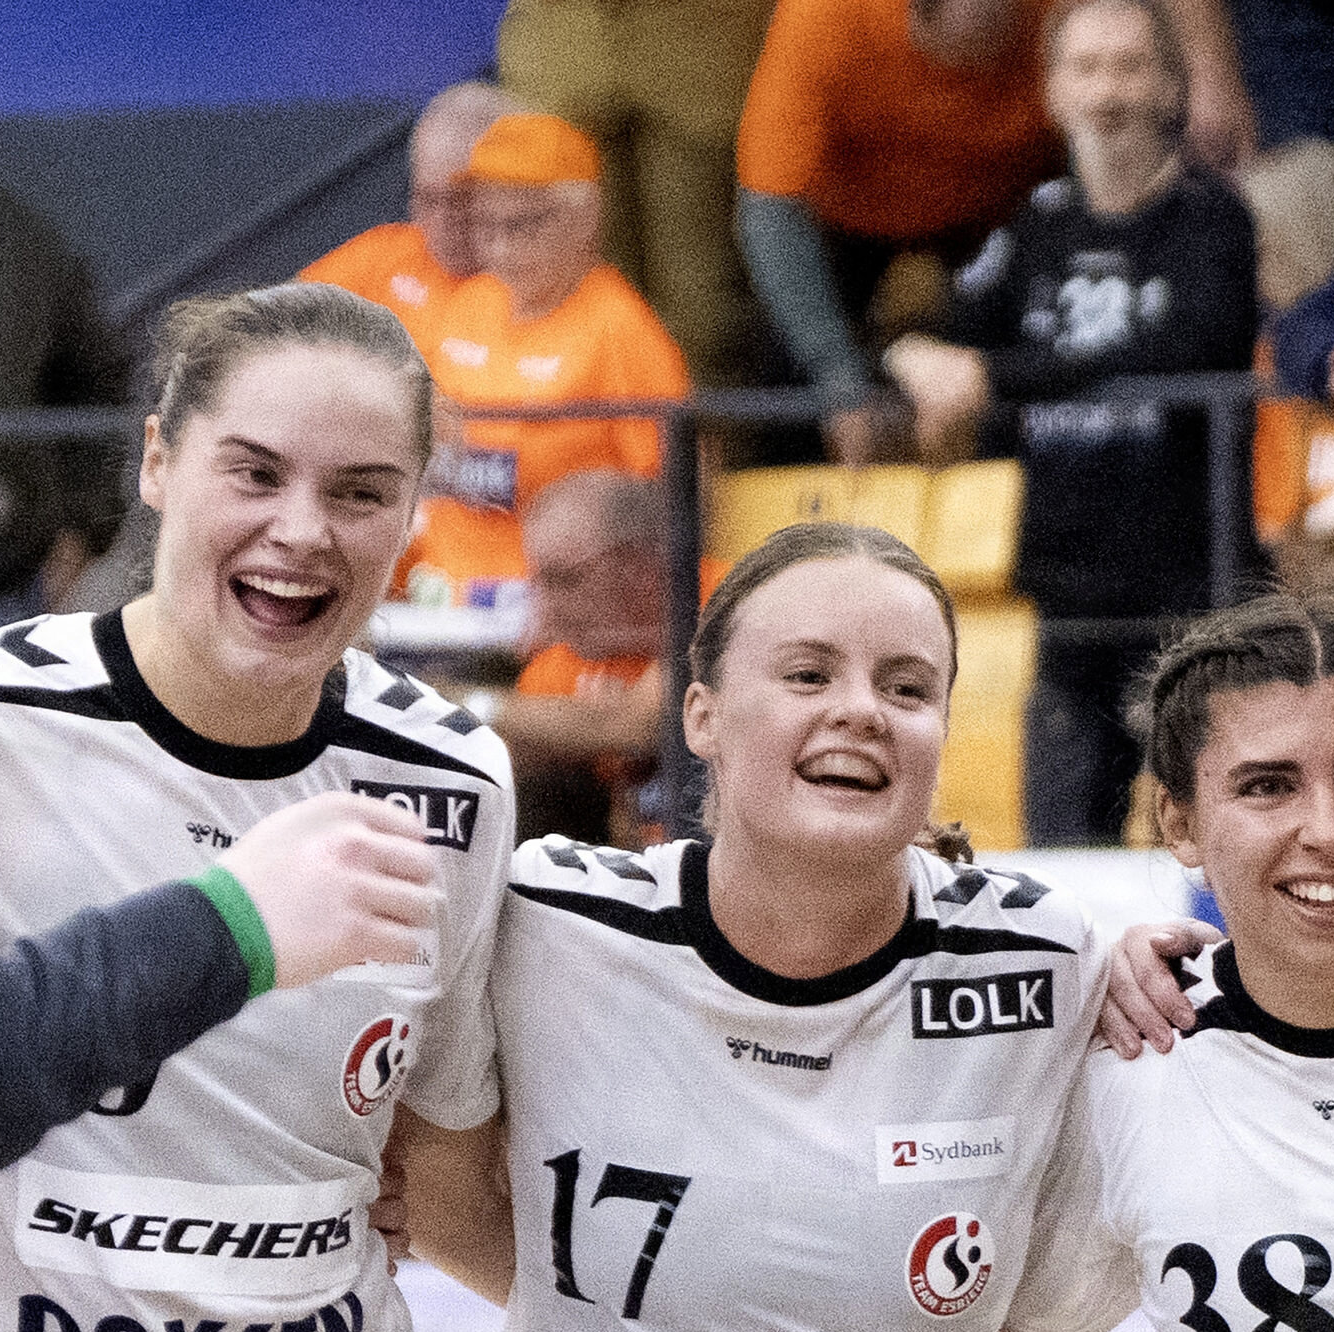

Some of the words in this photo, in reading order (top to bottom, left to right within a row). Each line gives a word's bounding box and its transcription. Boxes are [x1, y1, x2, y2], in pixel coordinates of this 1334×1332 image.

[359, 788, 470, 842] LK
[920, 979, 1044, 1031] LOLK
[752, 1042, 833, 1070] hummel
[921, 1136, 1004, 1162] Sydbank
[29, 1199, 351, 1259] SKECHERS
[543, 1148, 692, 1320] 17
